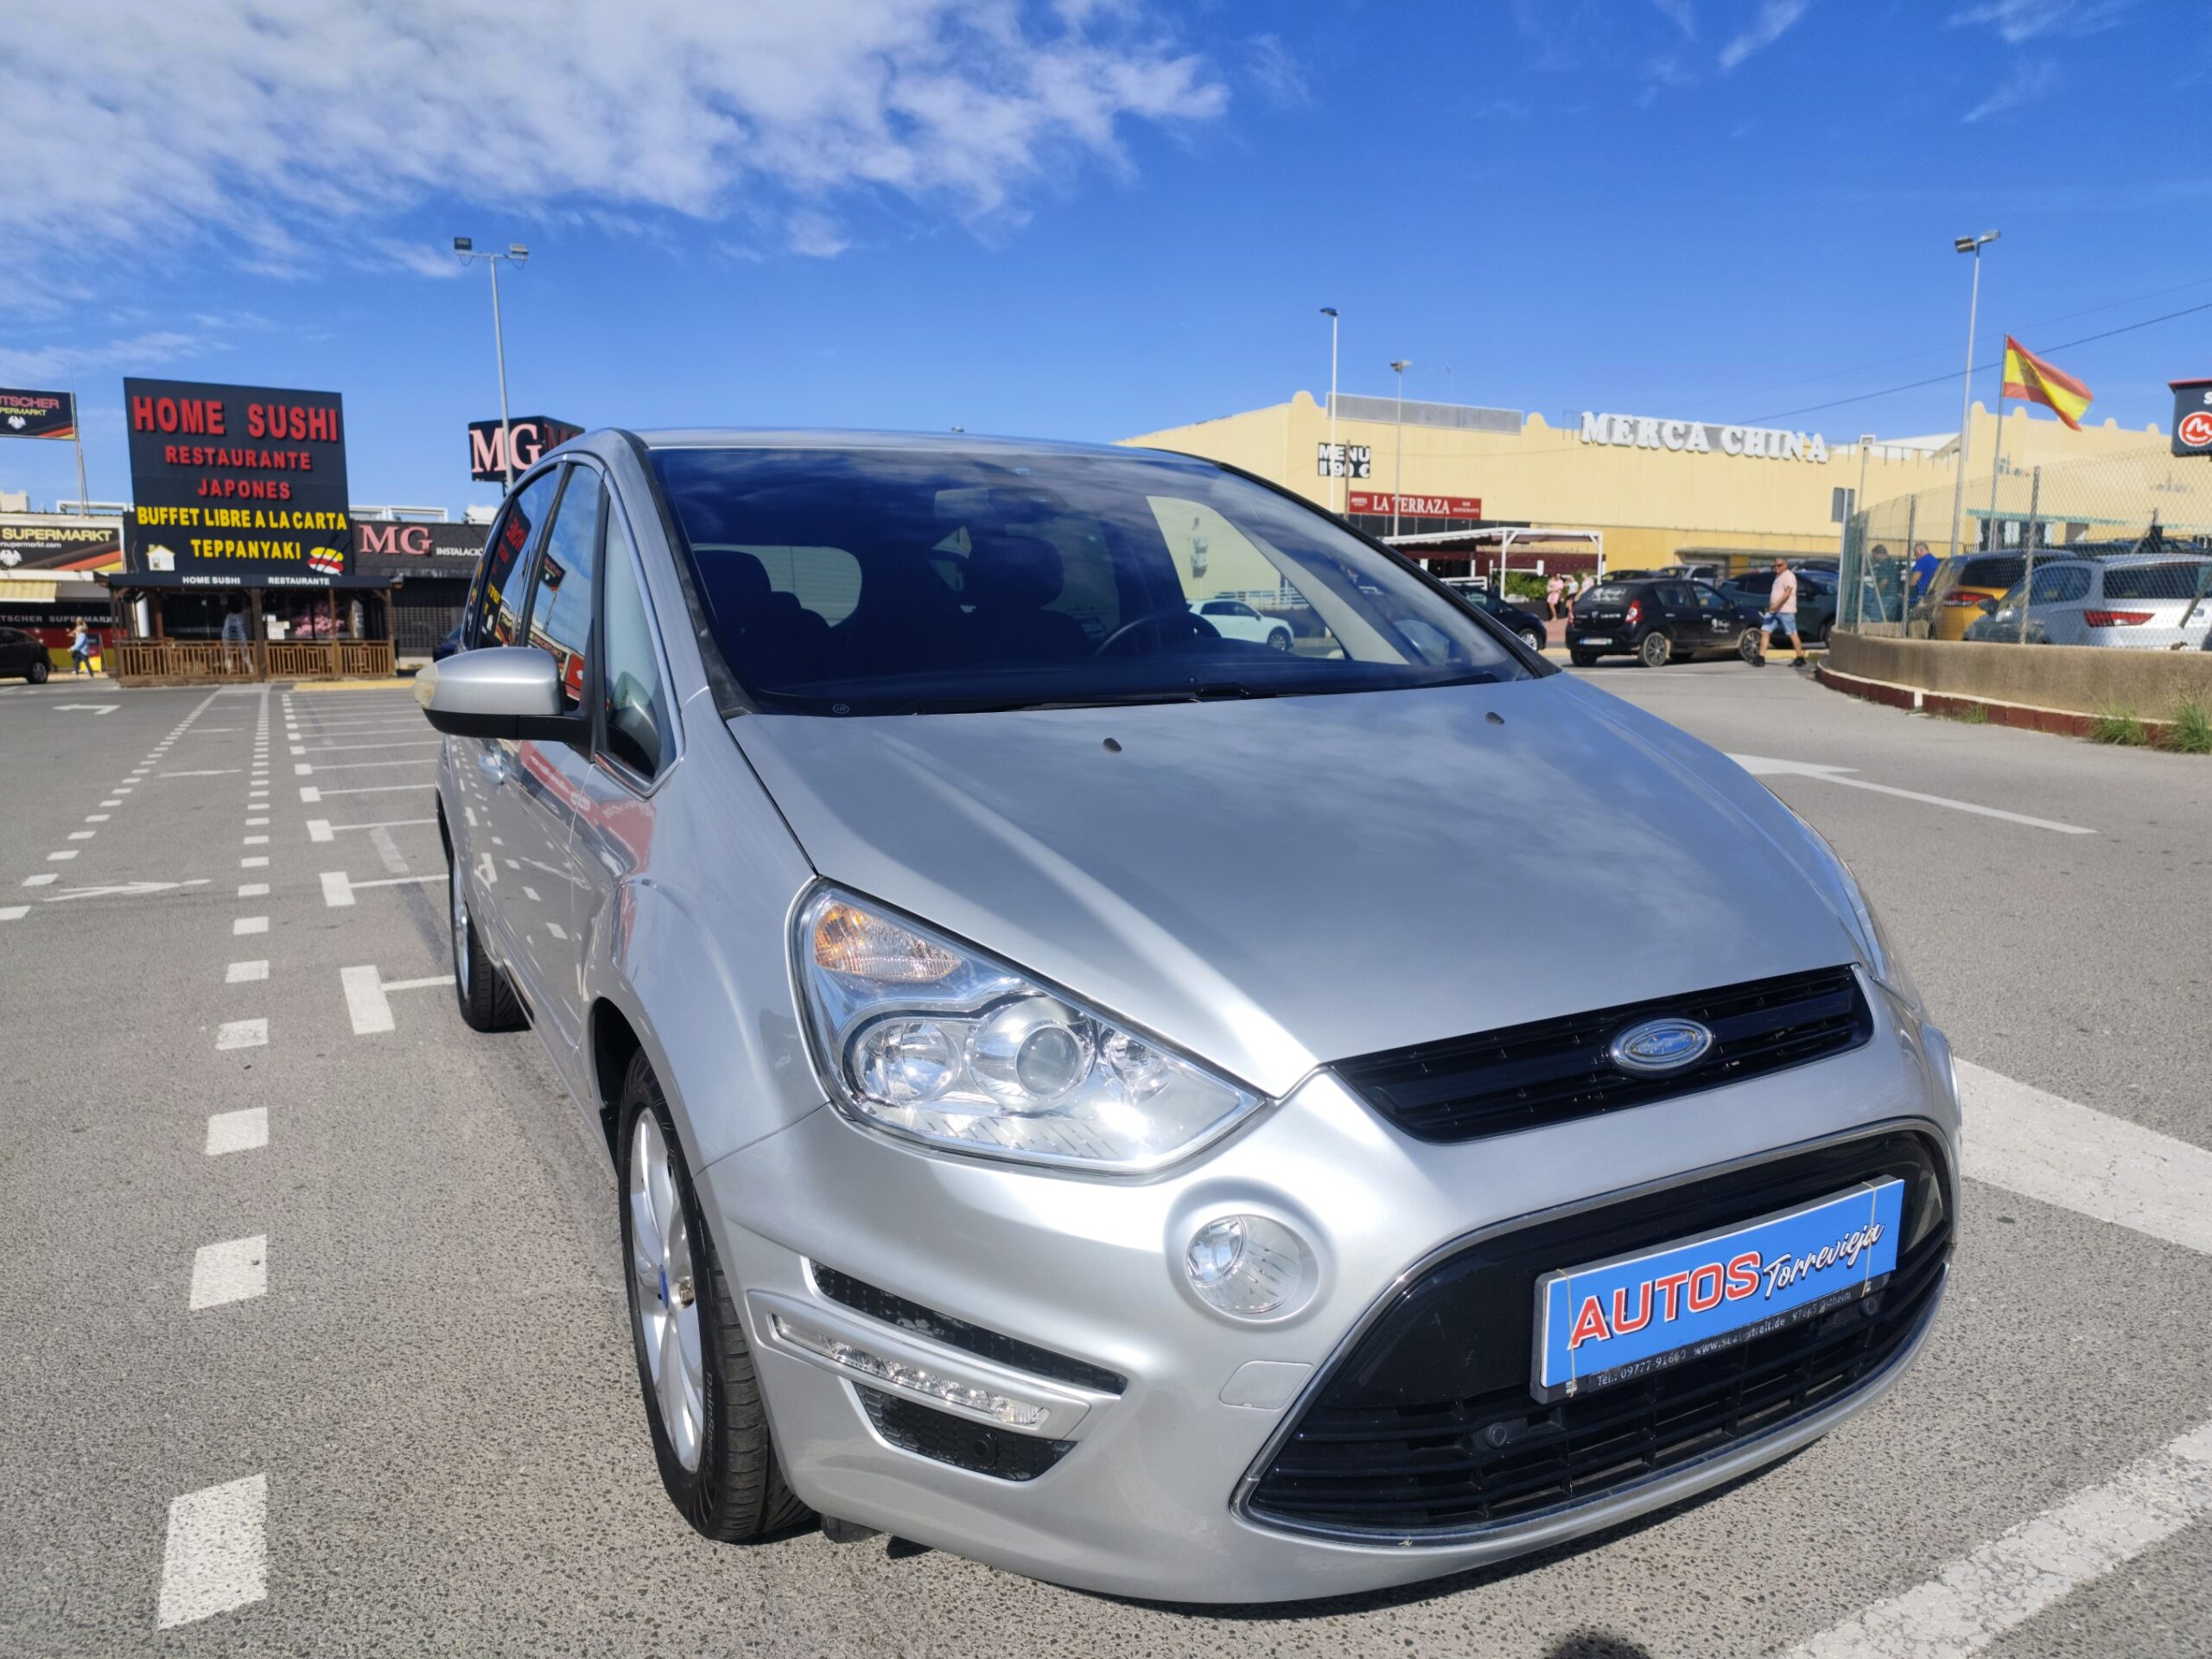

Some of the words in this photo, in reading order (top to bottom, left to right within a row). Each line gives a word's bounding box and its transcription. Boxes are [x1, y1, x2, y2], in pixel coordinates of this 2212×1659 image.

[132, 396, 226, 435] HOME
[247, 404, 339, 442] SUSHI
[469, 423, 543, 474] MG
[1580, 410, 1710, 453] MERCA
[1720, 425, 1830, 463] CHINA
[165, 445, 312, 470] RESTAURANTE
[197, 479, 291, 500] JAPONES
[1373, 495, 1389, 512] LA
[137, 506, 200, 526] BUFFET
[204, 508, 251, 529] LIBRE
[255, 511, 266, 529] A
[269, 511, 290, 529] LA
[293, 512, 347, 531] CARTA
[2, 527, 112, 542] SUPERMARKT
[359, 524, 434, 556] MG
[191, 539, 302, 560] TEPPANYAKI
[182, 576, 211, 585] HOME
[212, 576, 241, 585] SUSHI
[268, 576, 331, 586] RESTAURANTE
[1567, 1251, 1763, 1351] AUTOS
[1762, 1221, 1885, 1299] Torrevieja
